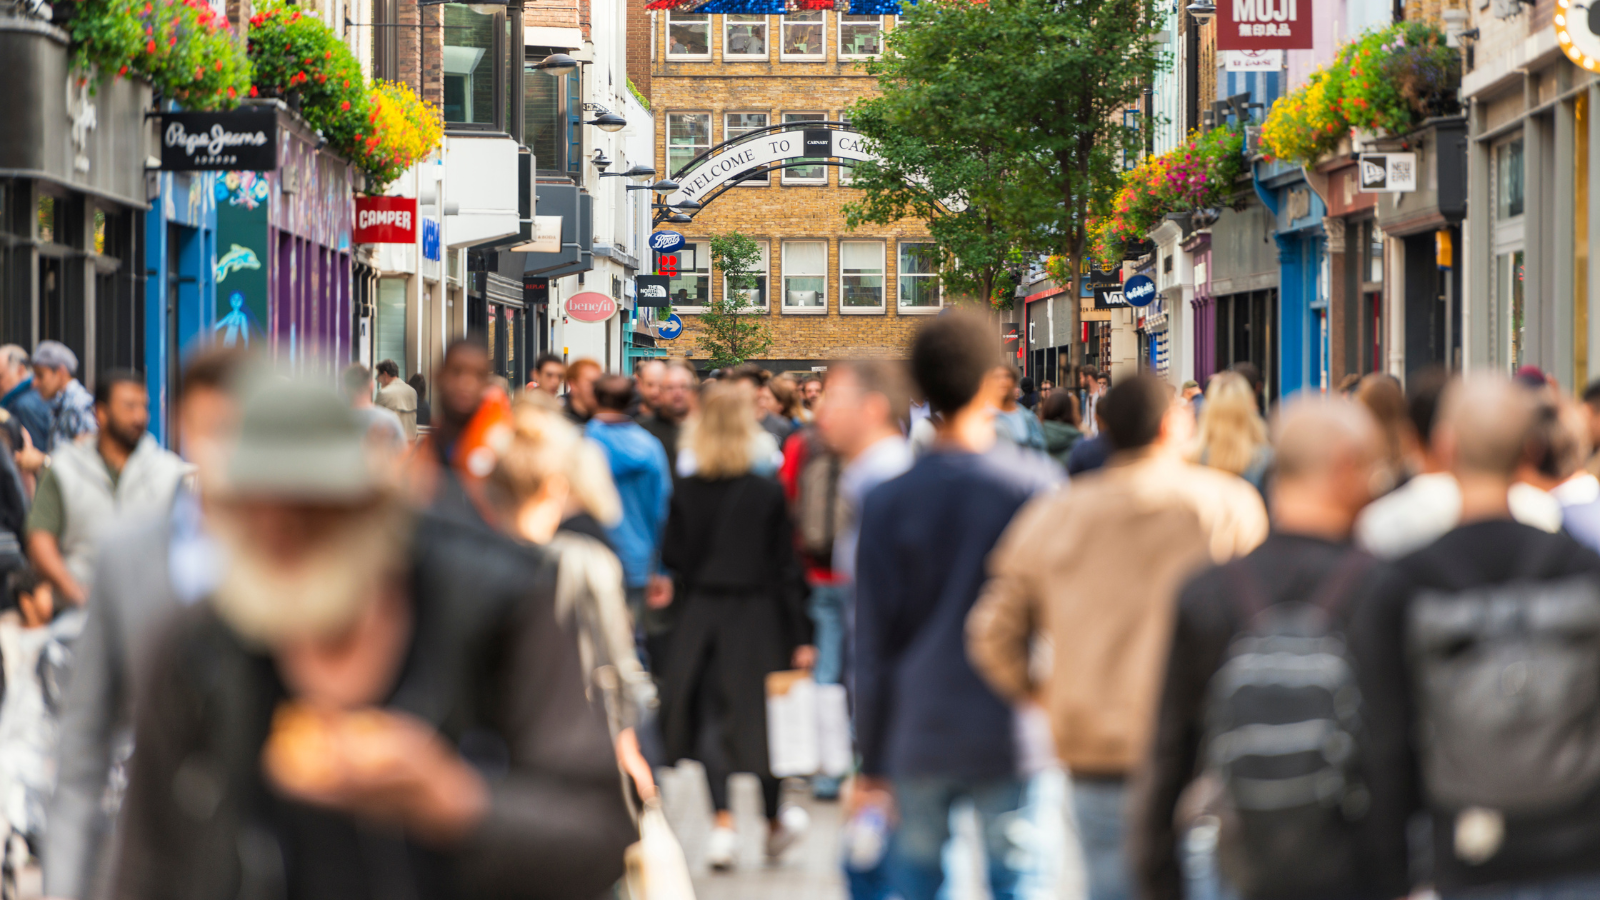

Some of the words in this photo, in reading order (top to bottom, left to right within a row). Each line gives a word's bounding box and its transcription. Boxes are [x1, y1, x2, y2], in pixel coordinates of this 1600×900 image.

[1232, 0, 1297, 22] MUJI
[1239, 23, 1291, 36] 無印良品
[165, 121, 211, 156] Pepe
[208, 123, 268, 156] Jeans
[681, 149, 756, 198] WELCOME
[769, 140, 790, 153] TO
[1391, 162, 1411, 171] NEW
[359, 210, 411, 231] CAMPER
[652, 234, 680, 248] Boots
[1102, 292, 1127, 304] VAN
[568, 299, 612, 314] benefit
